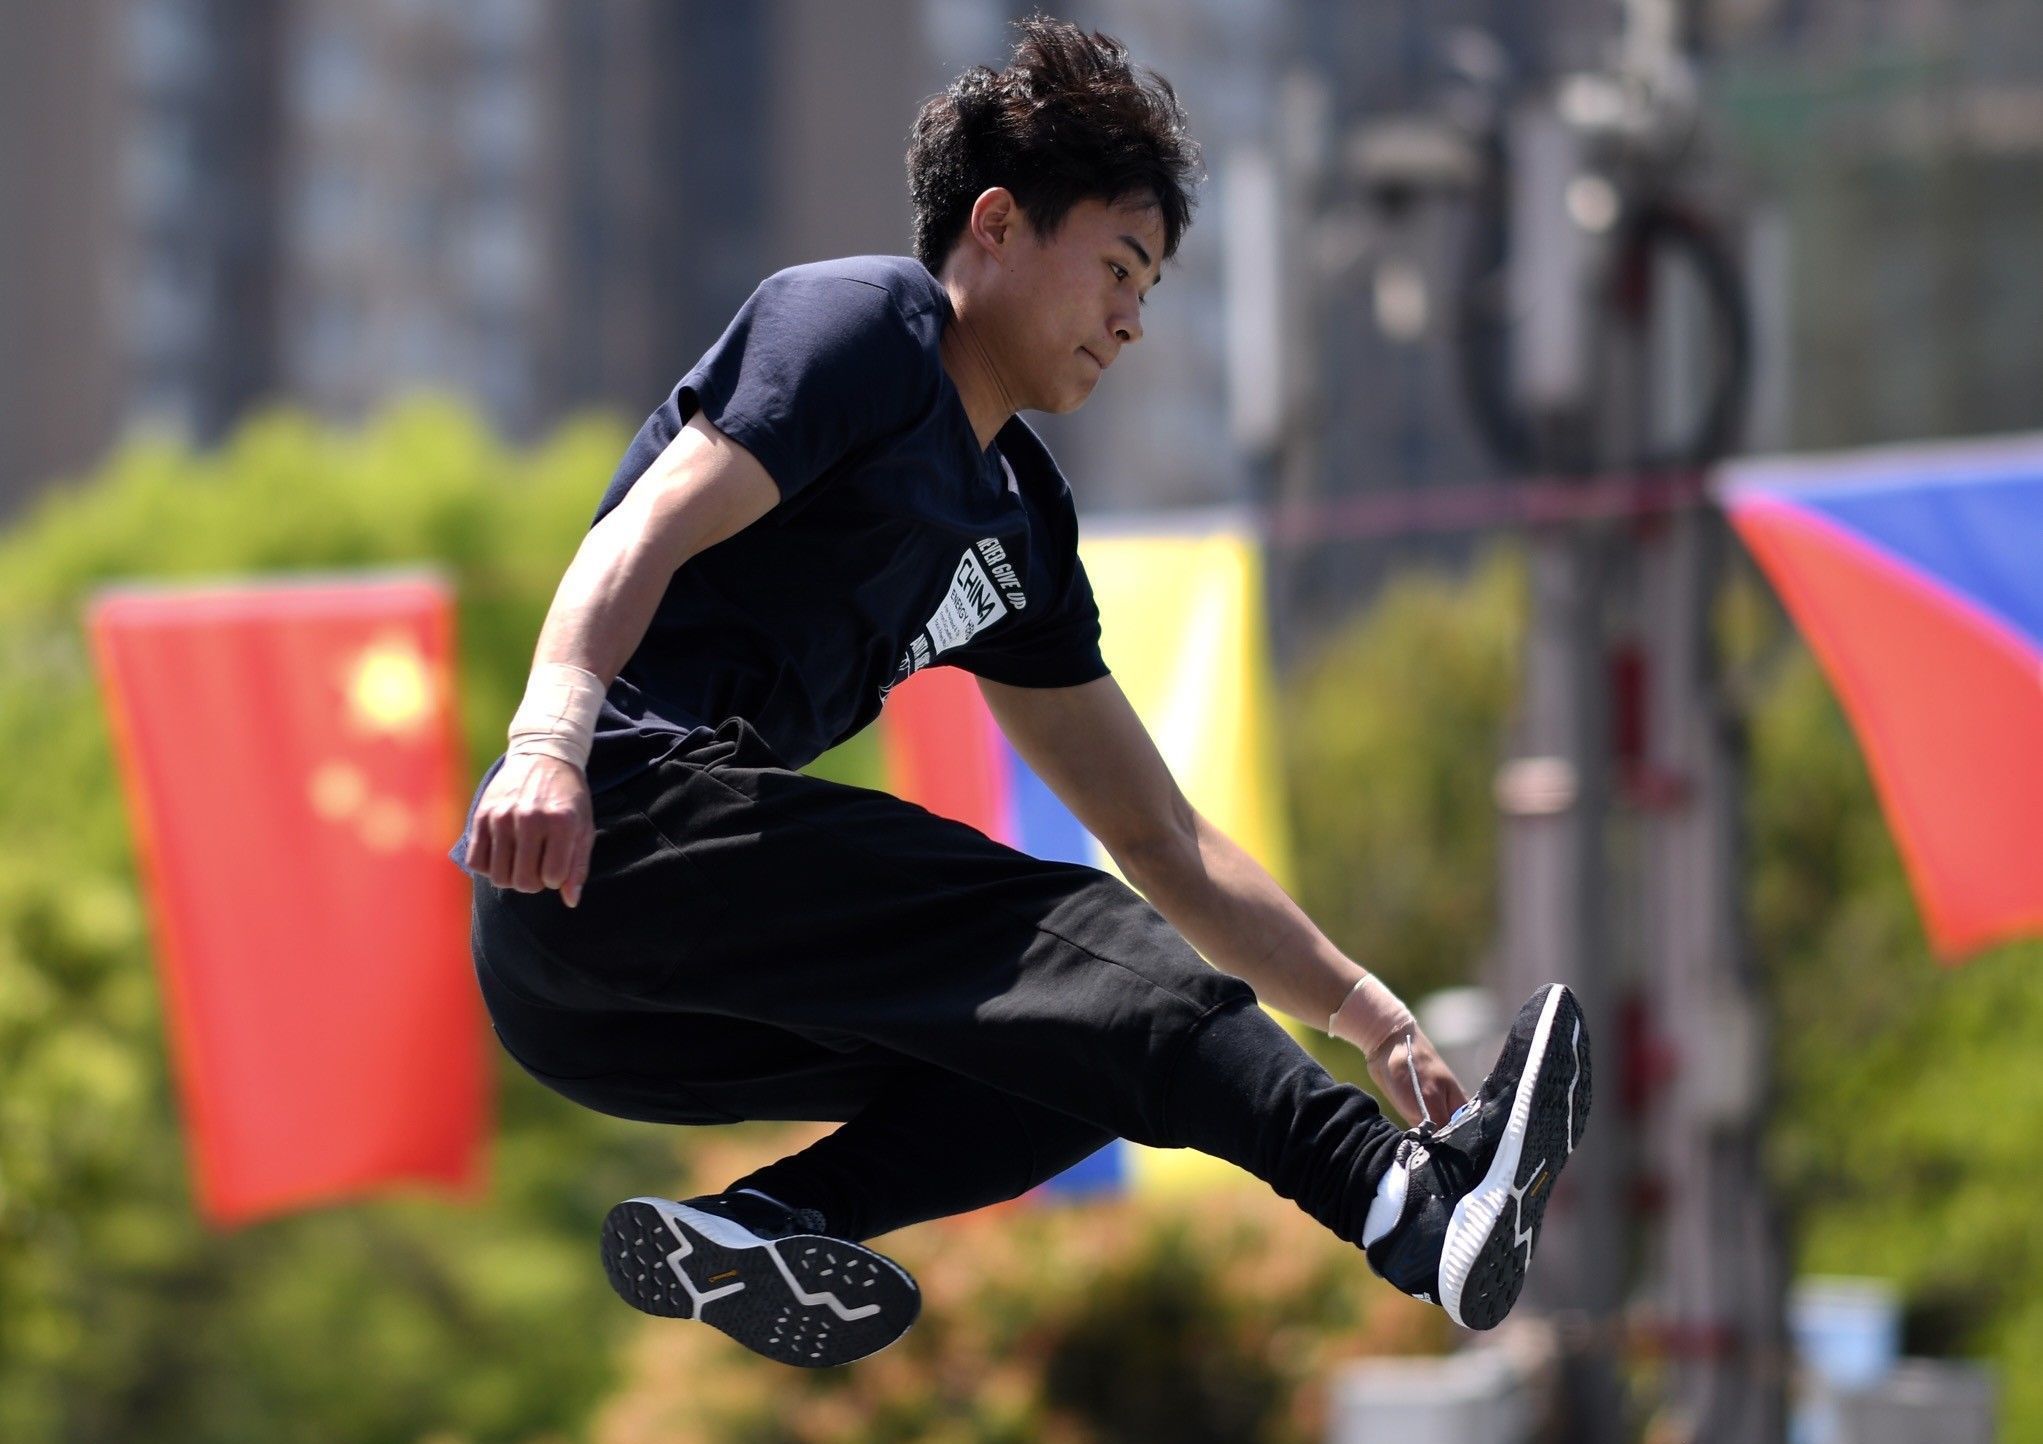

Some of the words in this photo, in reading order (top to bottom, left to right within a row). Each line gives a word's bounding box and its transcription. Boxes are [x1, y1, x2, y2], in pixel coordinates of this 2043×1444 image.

[950, 590, 969, 622] ENERGY
[957, 558, 995, 625] CHINA
[976, 537, 1006, 566] NEVER
[991, 563, 1021, 590] GIVE
[1006, 592, 1026, 610] UP
